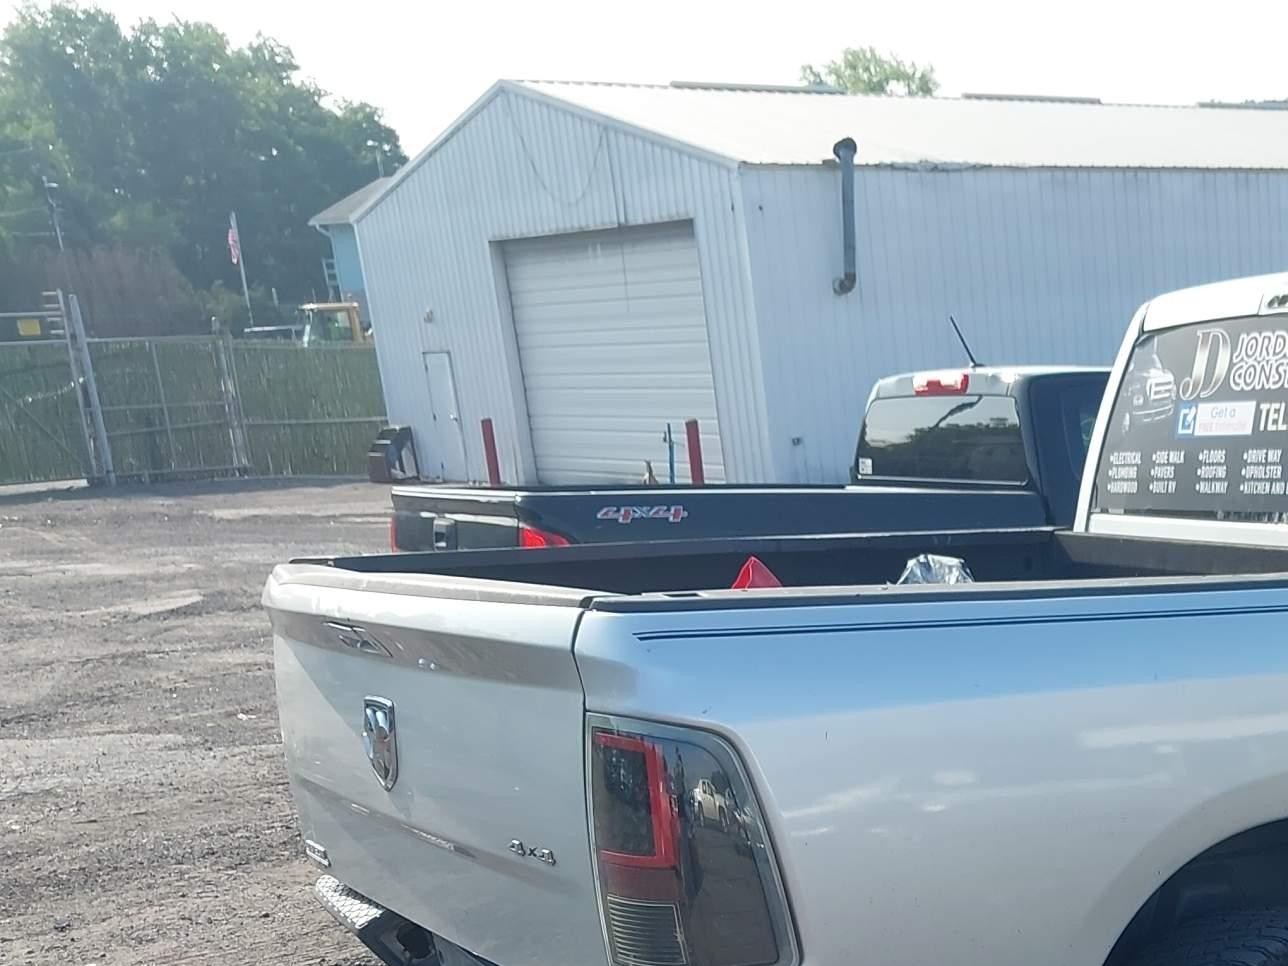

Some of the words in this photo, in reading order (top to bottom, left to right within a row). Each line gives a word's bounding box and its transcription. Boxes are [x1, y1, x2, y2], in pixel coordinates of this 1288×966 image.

[1202, 449, 1226, 463] FLOORS
[1247, 449, 1267, 463] DRIVE
[1267, 449, 1282, 463] WAY
[1200, 464, 1227, 479] ROOFING
[1199, 480, 1229, 494] WALKWAY
[1243, 480, 1271, 495] KITCHEN
[1270, 480, 1286, 495] AND
